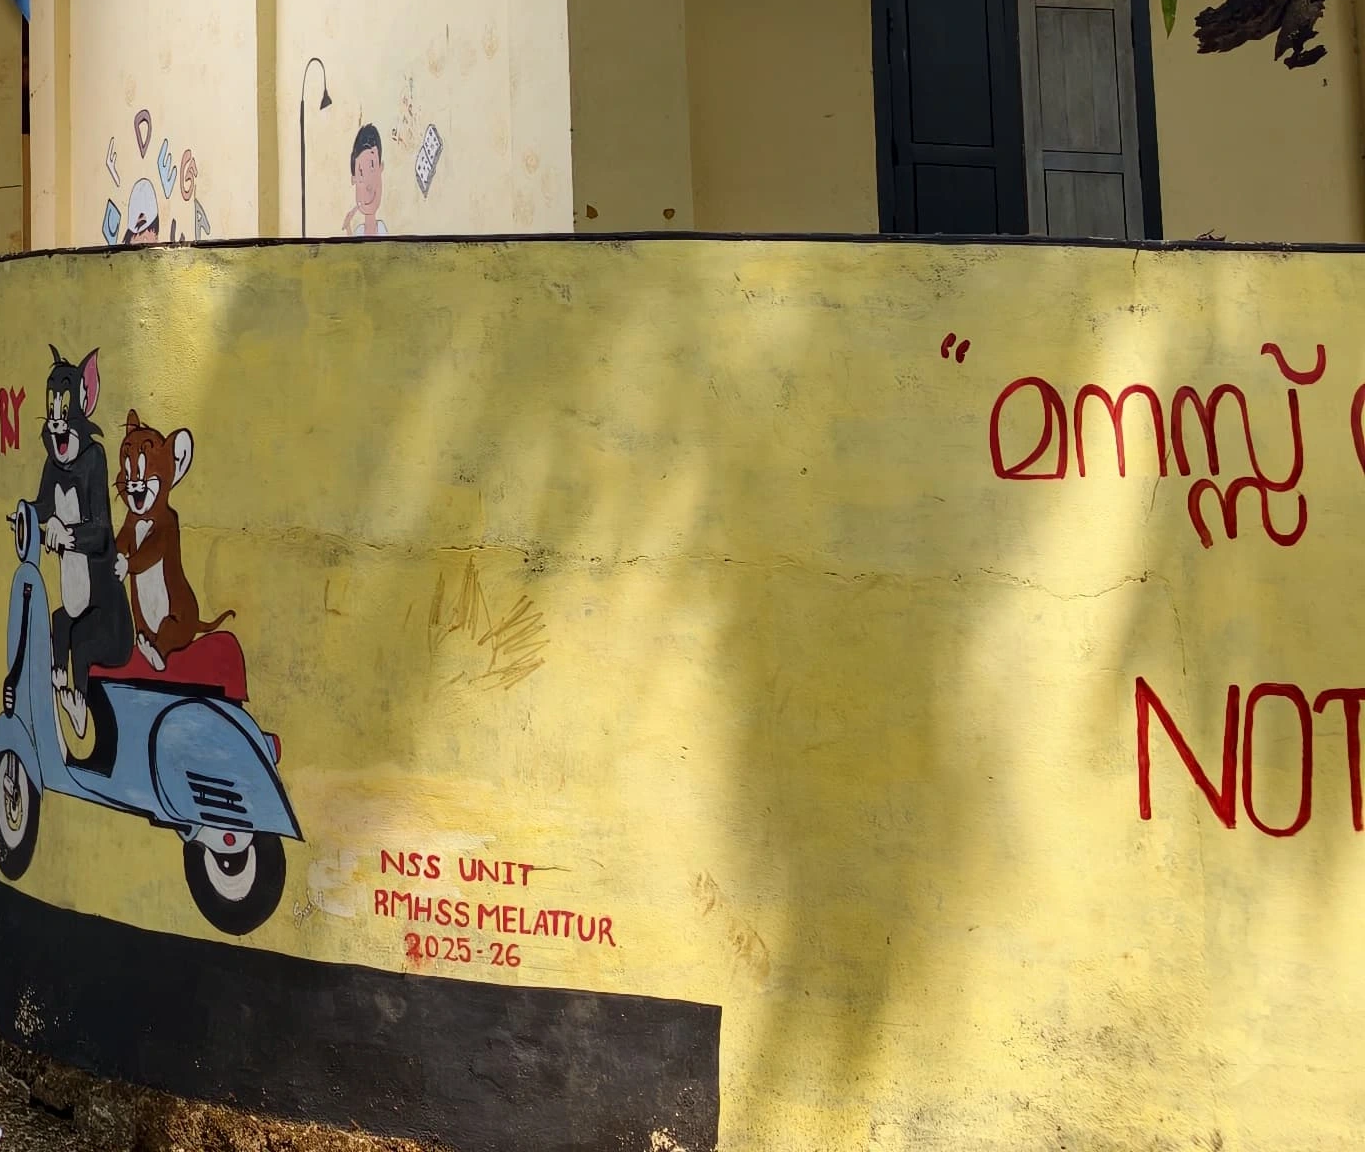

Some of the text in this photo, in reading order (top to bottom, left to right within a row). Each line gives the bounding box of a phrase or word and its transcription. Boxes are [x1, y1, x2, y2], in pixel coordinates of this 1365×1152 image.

[380, 850, 534, 886] NSS UNIT
[374, 889, 470, 928] RMHSS
[477, 903, 617, 947] MELATTUR
